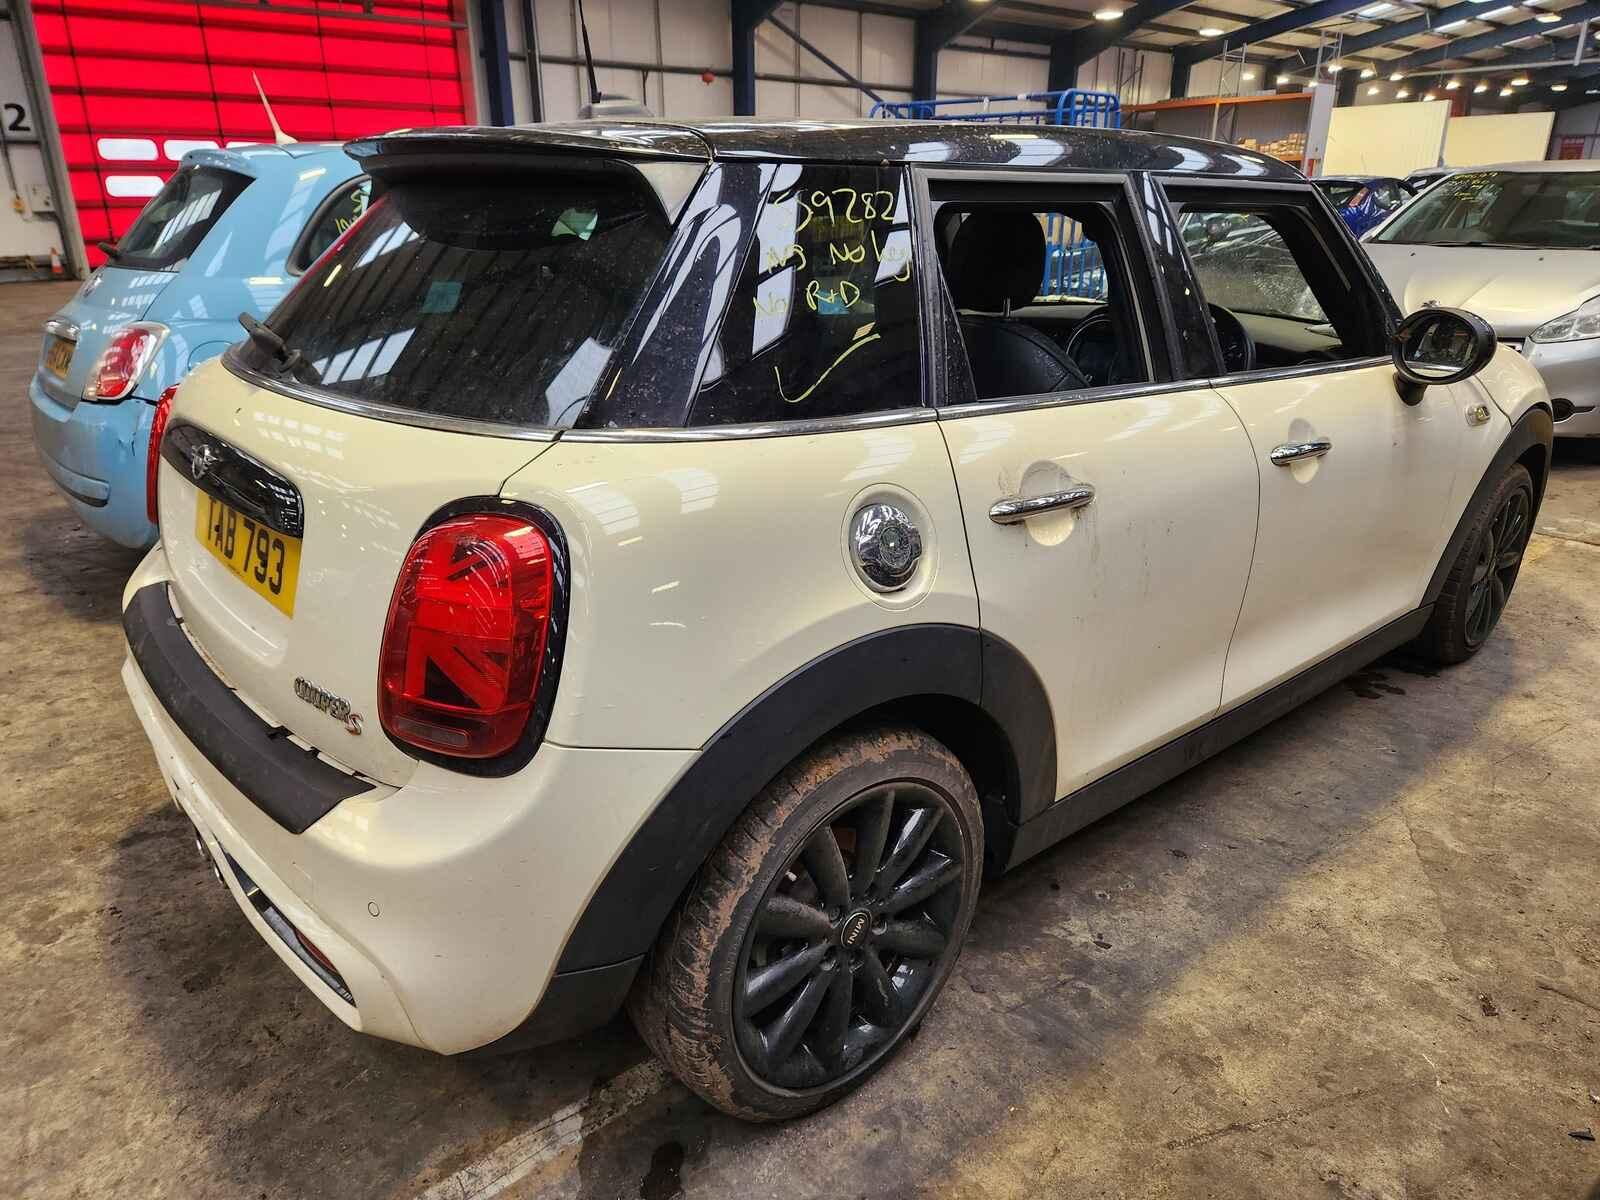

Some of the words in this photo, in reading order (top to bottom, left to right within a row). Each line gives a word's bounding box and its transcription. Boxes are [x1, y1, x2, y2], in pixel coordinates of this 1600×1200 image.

[4, 103, 31, 131] 2
[243, 517, 285, 595] 793
[847, 917, 866, 945] MINI
